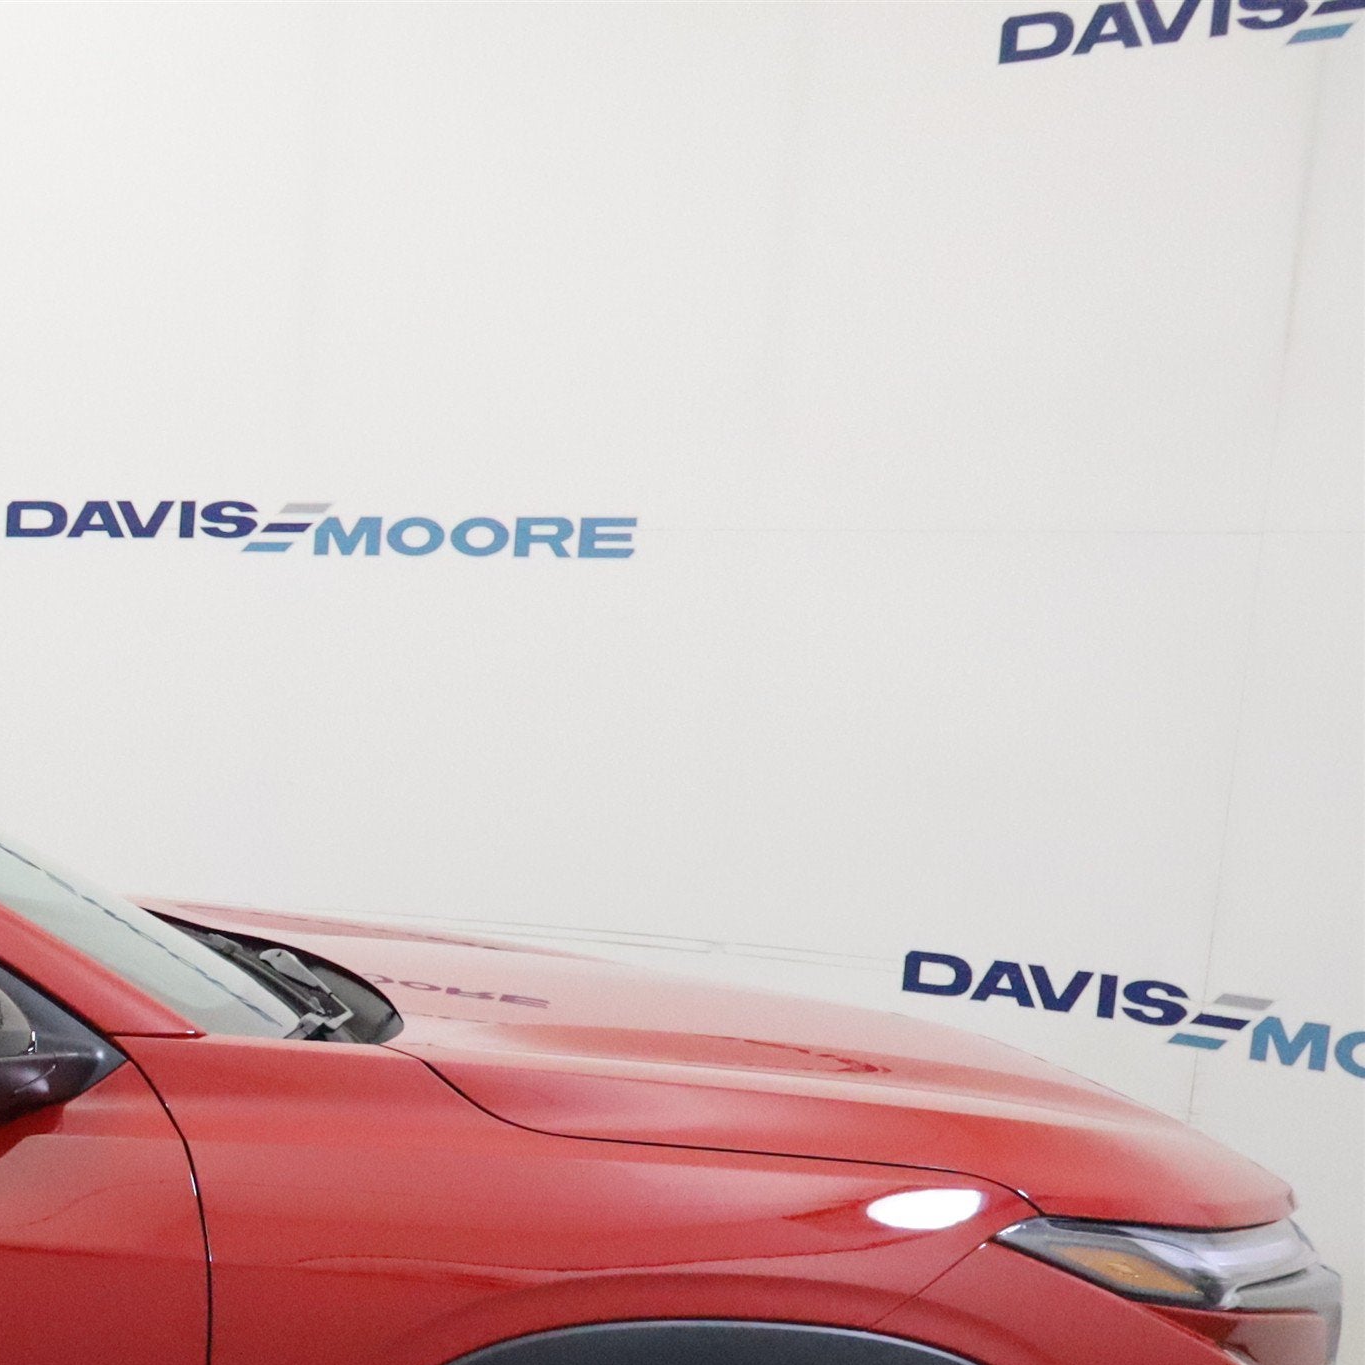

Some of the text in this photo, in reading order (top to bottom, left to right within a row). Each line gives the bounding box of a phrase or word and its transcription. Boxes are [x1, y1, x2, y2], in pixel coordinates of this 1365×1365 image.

[998, 0, 1308, 65] DAVIS
[5, 500, 638, 559] DAVIS MOORE
[902, 950, 1189, 1027] DAVIS
